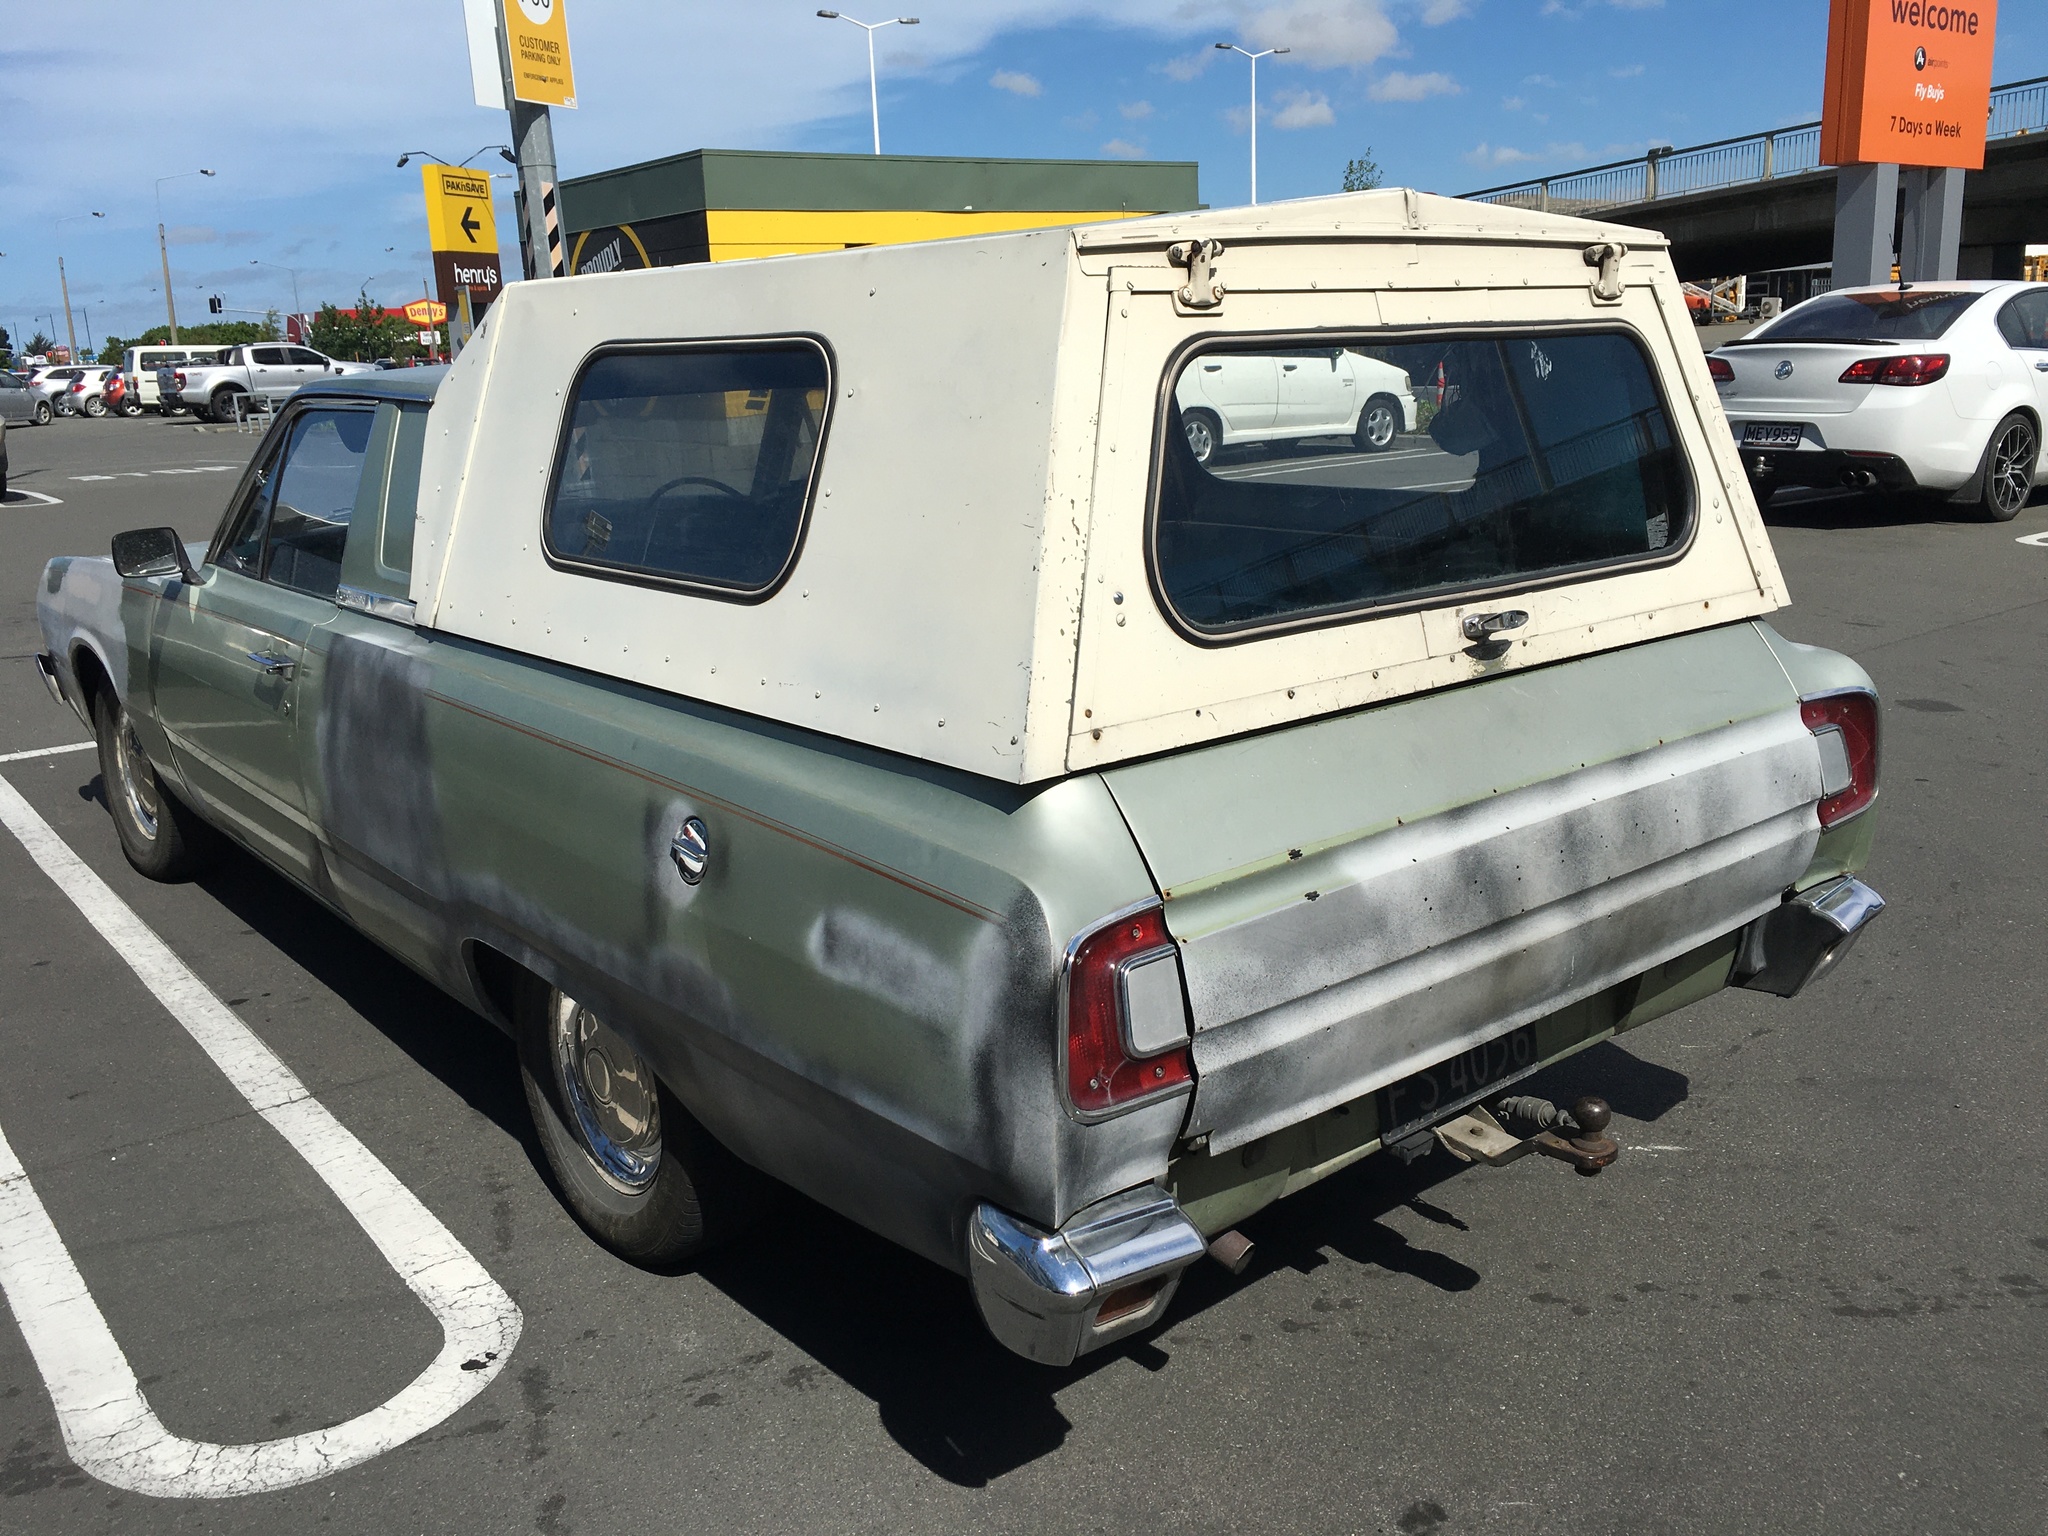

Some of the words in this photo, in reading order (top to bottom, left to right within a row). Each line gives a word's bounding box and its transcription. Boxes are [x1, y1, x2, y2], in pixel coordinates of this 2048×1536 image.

[1892, 0, 1979, 35] welcome
[519, 34, 561, 54] CUSTOMER
[521, 49, 546, 63] PARKING
[547, 54, 561, 66] ONLY
[1915, 83, 1928, 101] Fly
[1890, 116, 1897, 132] 7
[1899, 116, 1923, 138] Days
[1925, 122, 1933, 135] a
[1935, 120, 1962, 138] Week
[454, 262, 498, 291] henry's
[410, 306, 443, 318] Deny's
[1746, 426, 1799, 442] MEY955
